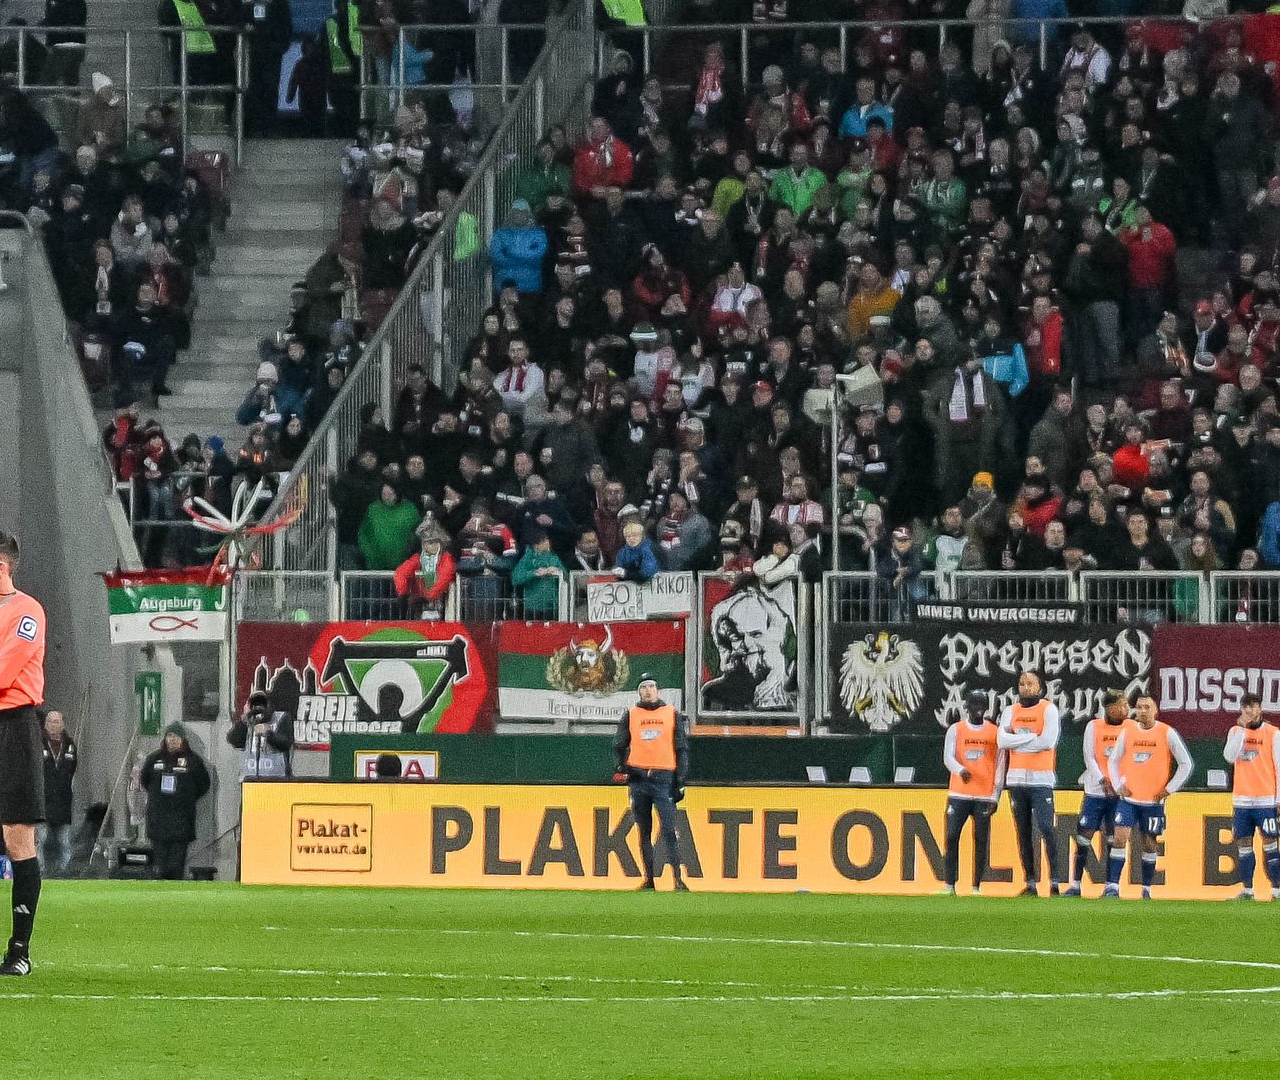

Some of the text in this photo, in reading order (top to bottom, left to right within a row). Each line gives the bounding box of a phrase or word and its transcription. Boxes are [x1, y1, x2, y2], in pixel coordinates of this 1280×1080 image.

[139, 596, 202, 611] Augsburg
[916, 604, 1077, 623] IMMER UNVERGESSEN
[297, 695, 360, 721] FREIE
[298, 818, 367, 838] Plakat-
[429, 805, 798, 880] PLAKATE
